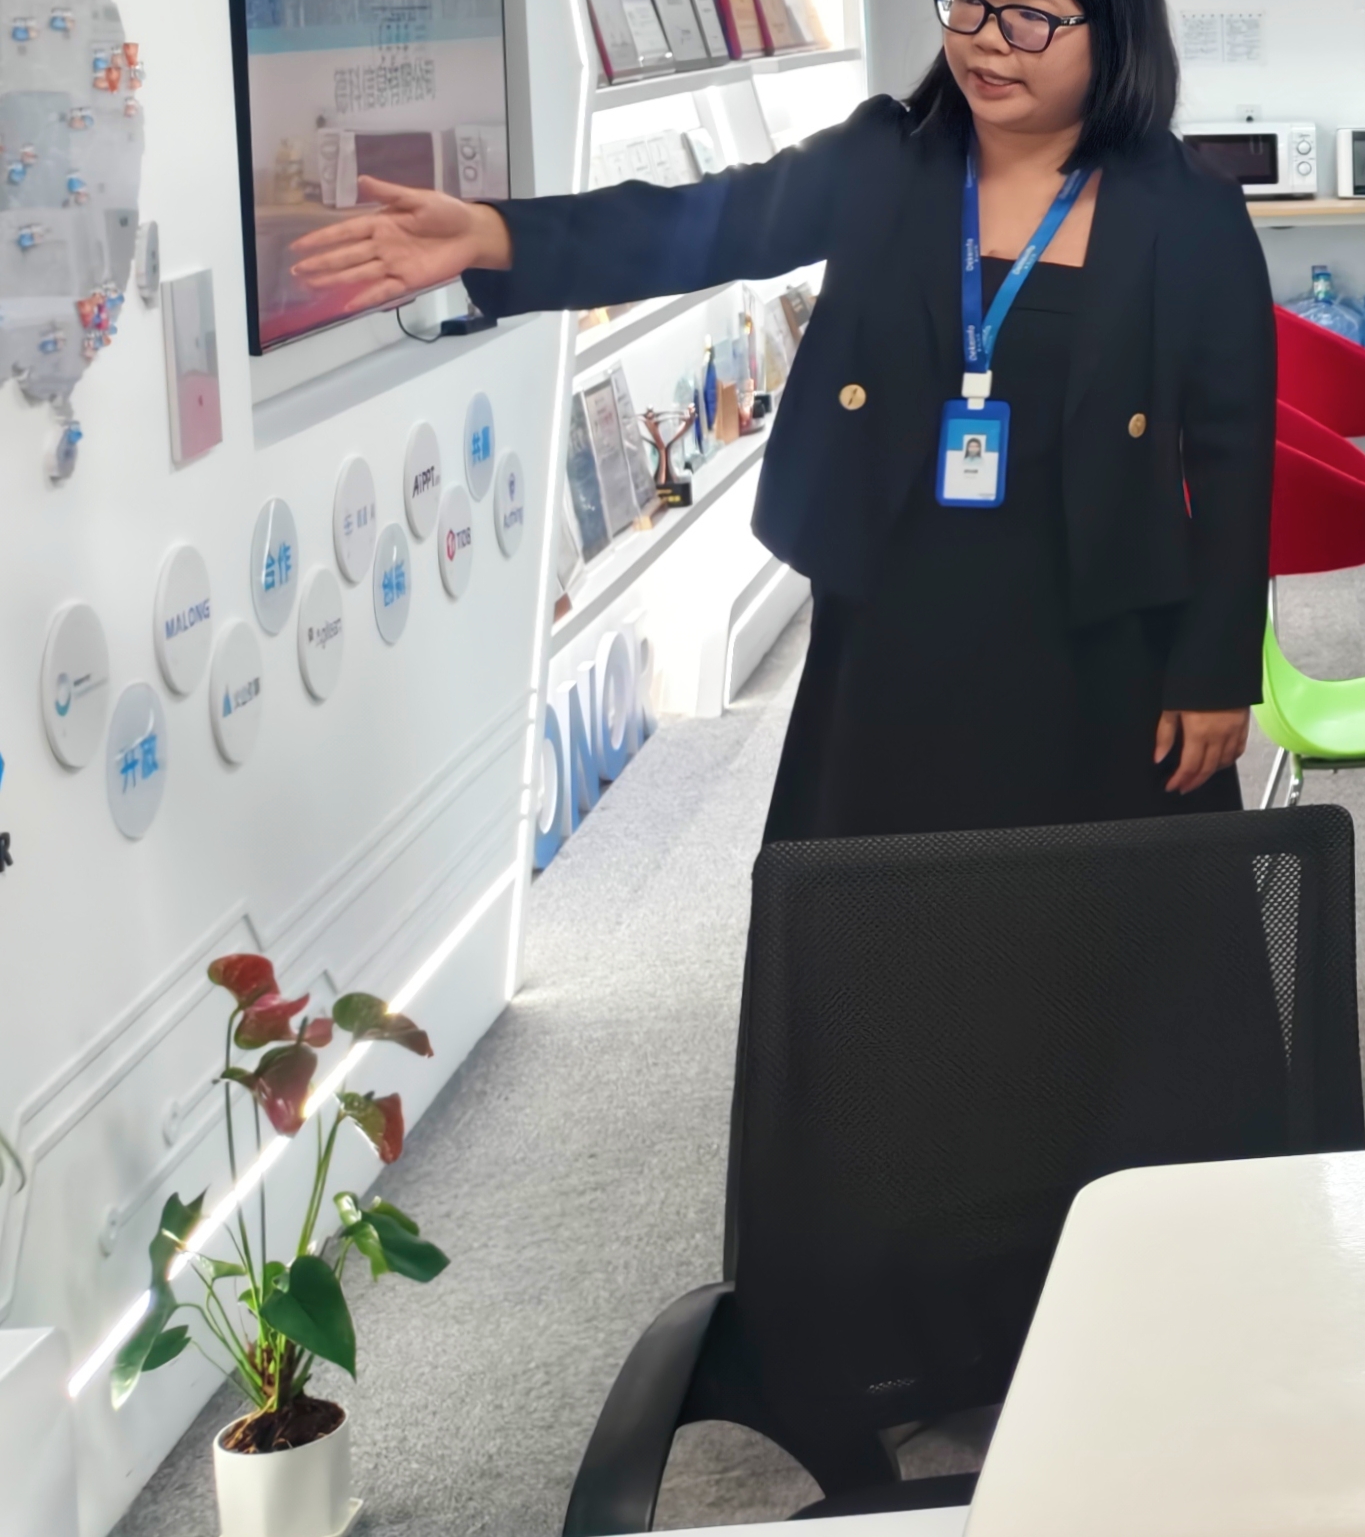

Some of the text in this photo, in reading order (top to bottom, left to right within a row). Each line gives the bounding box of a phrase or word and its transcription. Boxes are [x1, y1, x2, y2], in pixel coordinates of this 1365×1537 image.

[263, 543, 292, 593] 合作
[165, 599, 211, 641] MALONG
[119, 733, 160, 794] 开放
